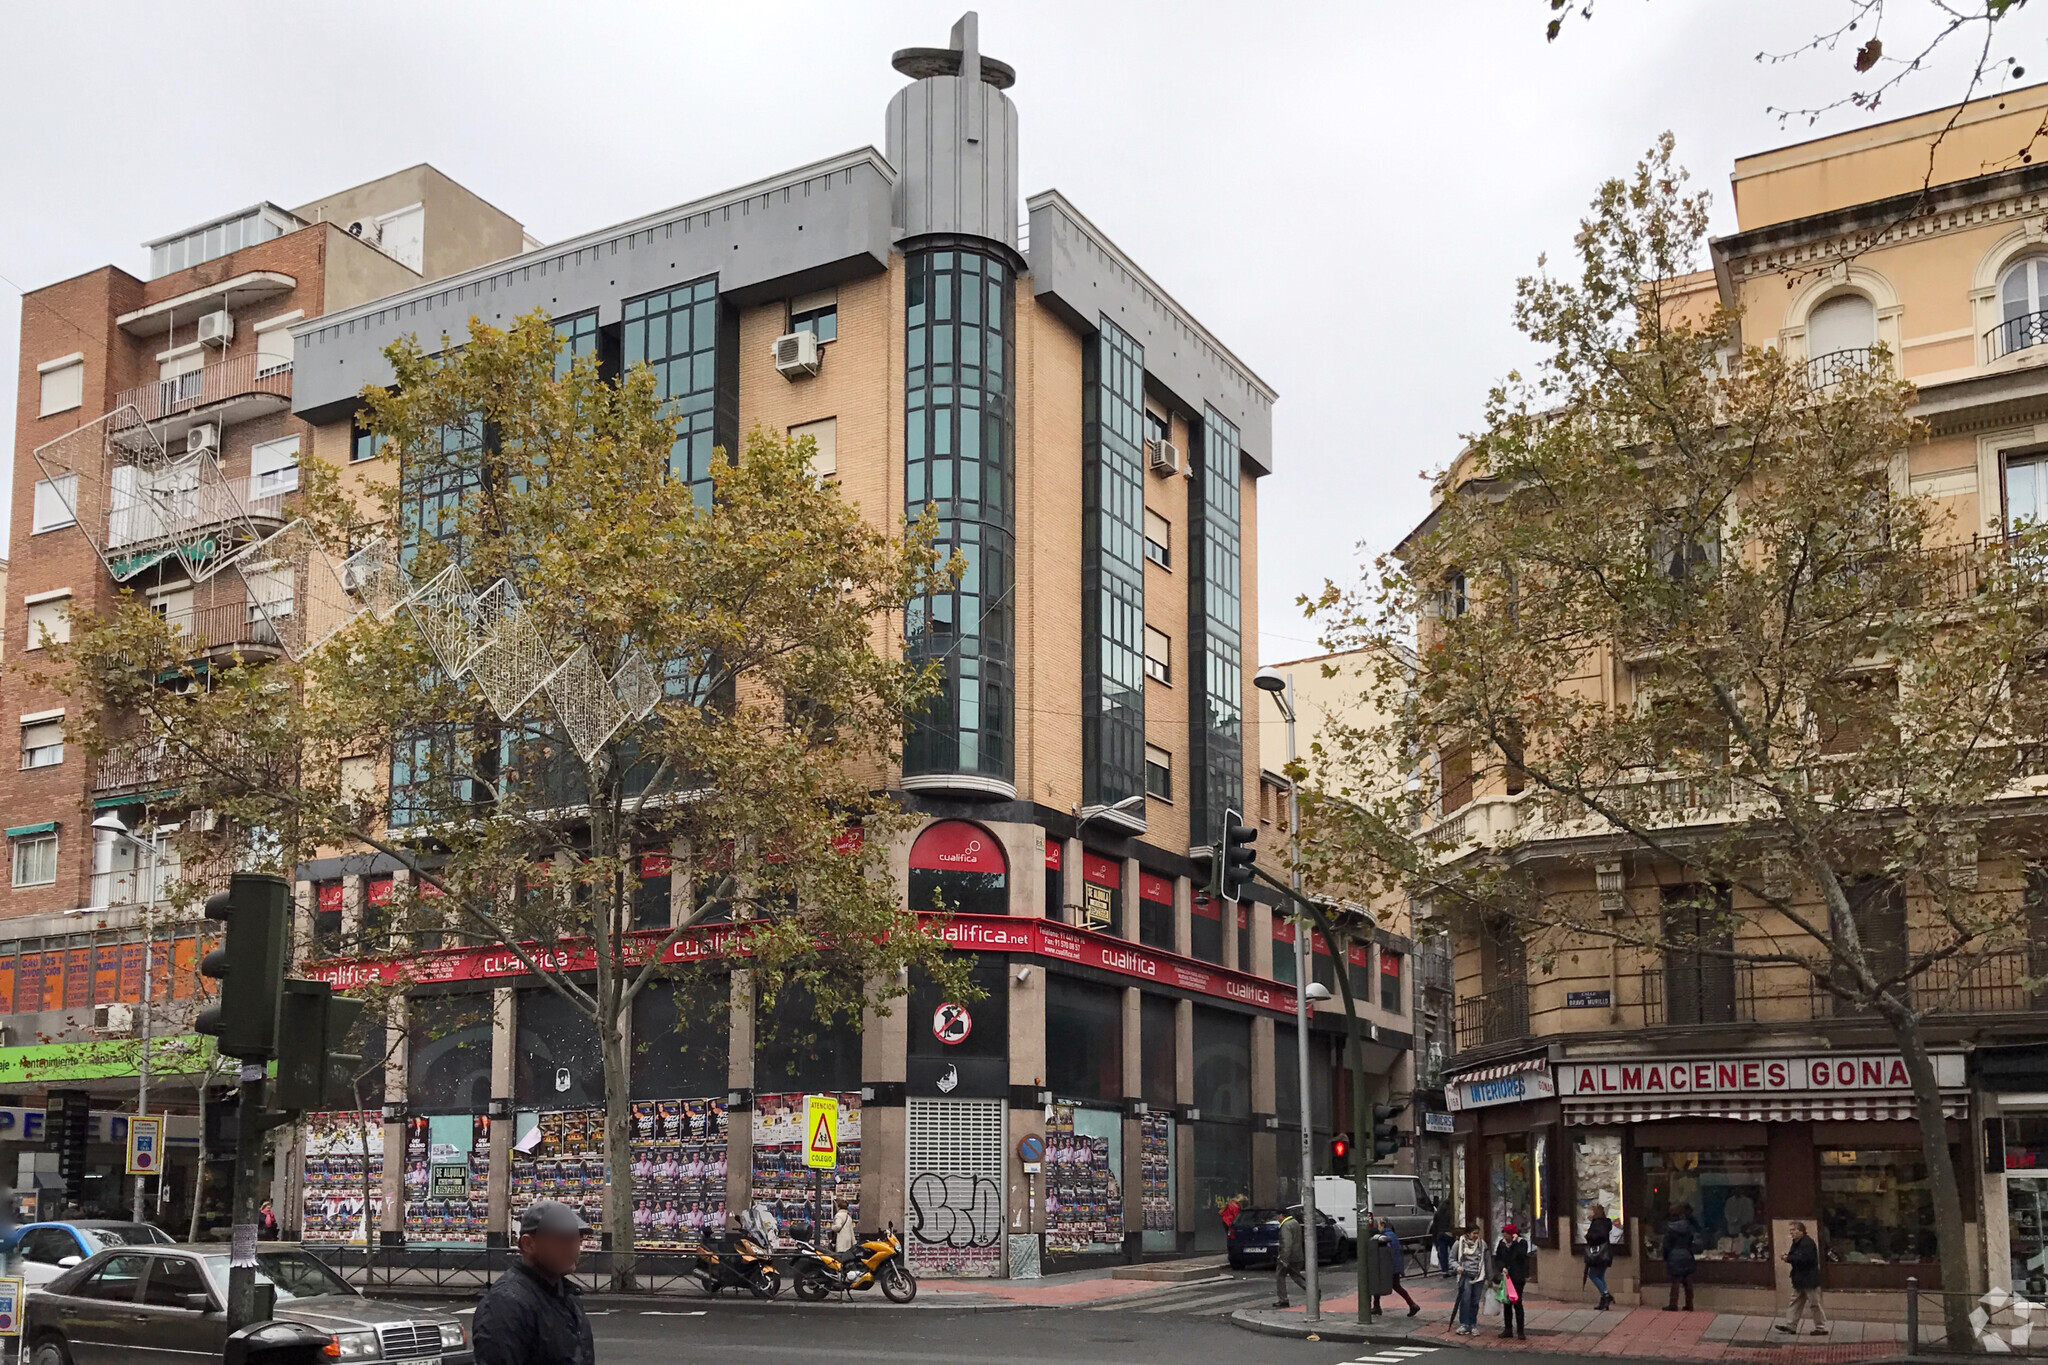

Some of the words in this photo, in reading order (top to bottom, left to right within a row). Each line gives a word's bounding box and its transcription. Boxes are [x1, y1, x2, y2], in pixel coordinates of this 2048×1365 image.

[939, 853, 978, 863] cualifica
[1055, 938, 1061, 946] 91
[1102, 949, 1156, 976] cualifica
[1226, 981, 1270, 1004] cualifica
[1578, 1063, 1785, 1093] ALMACENES
[1811, 1060, 1909, 1086] GONA
[1471, 1076, 1526, 1103] INTERIORES
[811, 1154, 833, 1163] COLEGIO
[443, 1168, 465, 1178] ALQUILA
